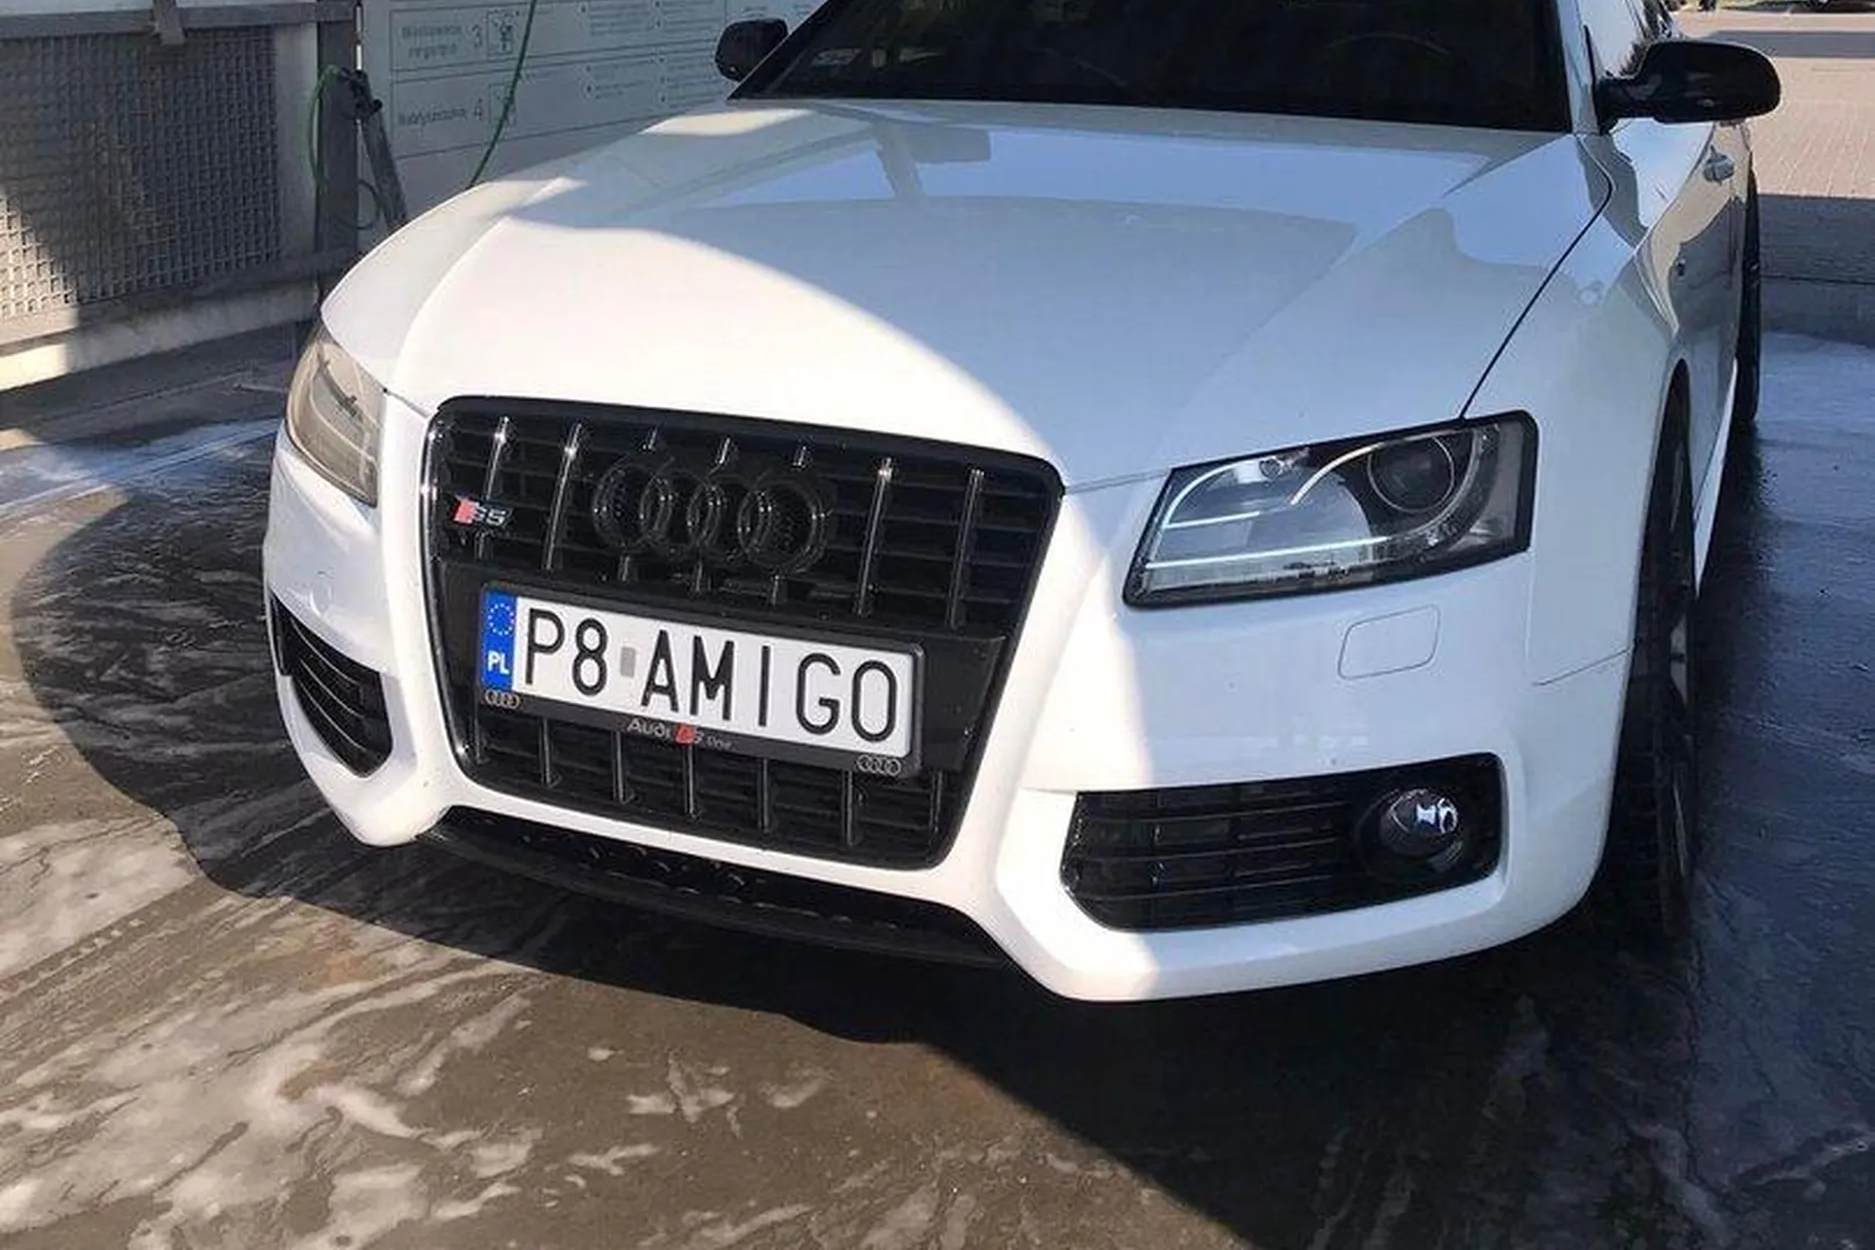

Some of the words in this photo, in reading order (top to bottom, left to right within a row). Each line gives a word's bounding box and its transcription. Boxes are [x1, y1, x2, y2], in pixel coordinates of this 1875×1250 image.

[488, 651, 509, 675] PL
[525, 607, 609, 697] P8
[641, 629, 898, 743] AMIGO
[627, 718, 671, 739] Audi
